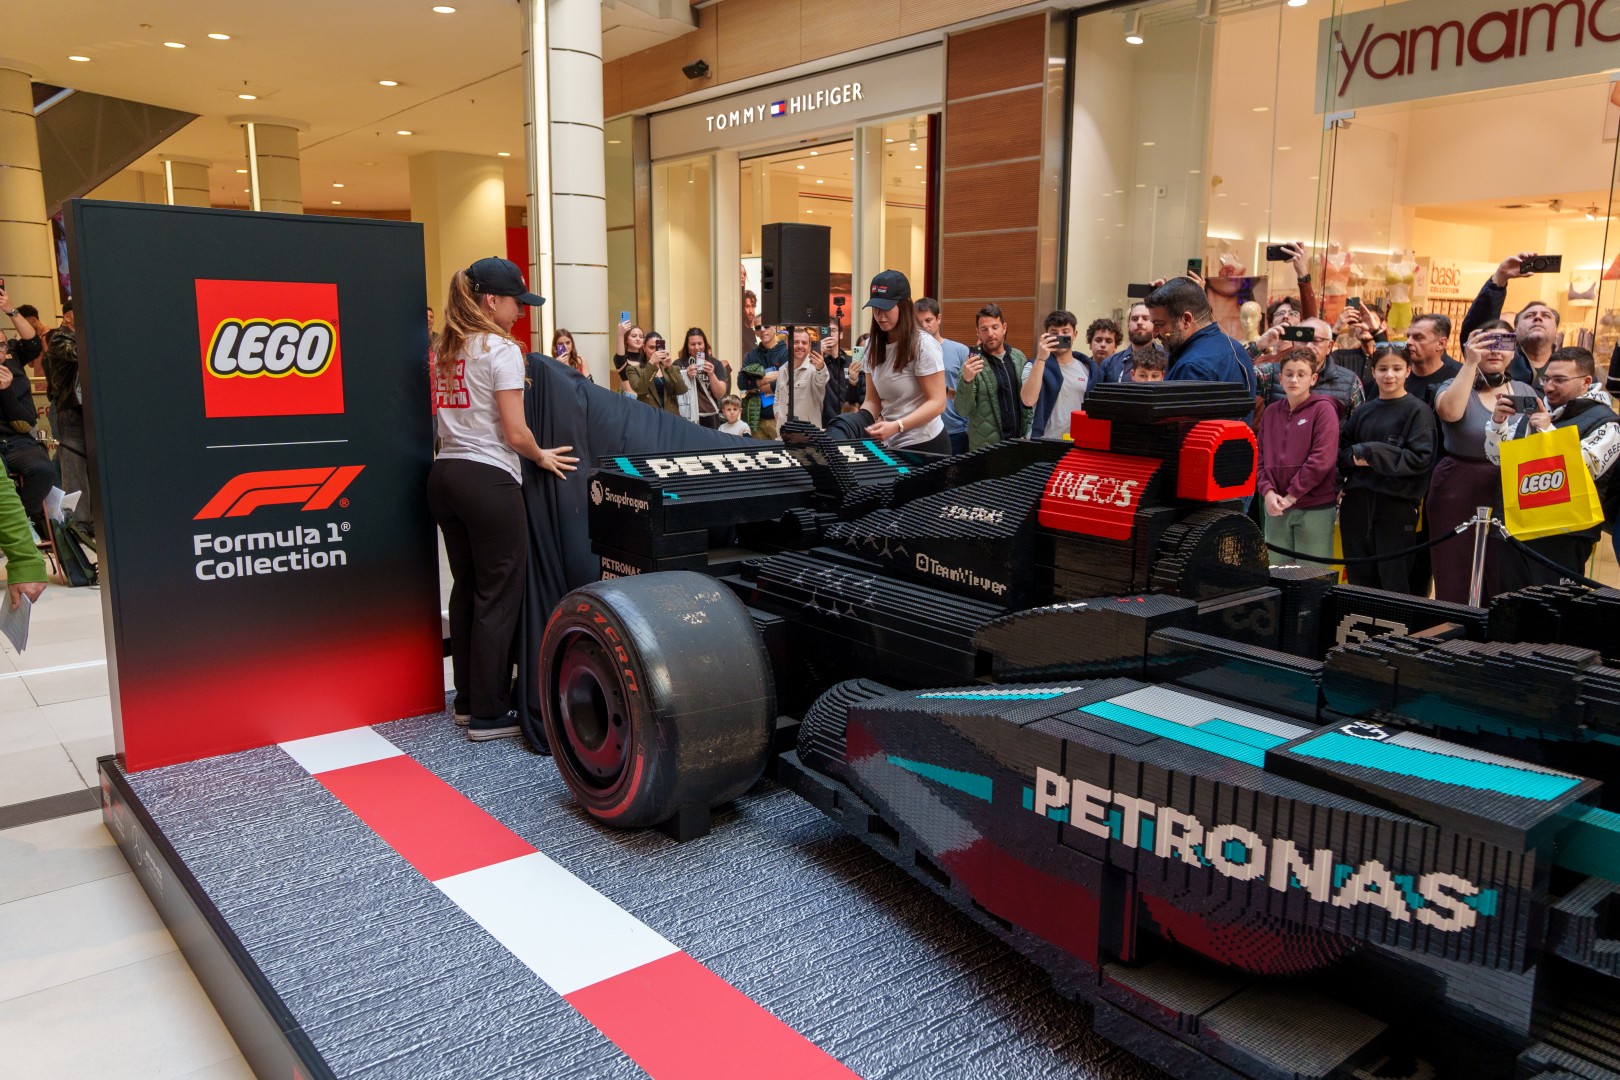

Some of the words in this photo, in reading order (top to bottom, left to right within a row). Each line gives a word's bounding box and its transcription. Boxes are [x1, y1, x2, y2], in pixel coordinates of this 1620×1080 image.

[706, 104, 766, 132] TOMMY
[790, 82, 865, 114] HILFIGER
[1430, 260, 1461, 287] basic
[209, 320, 334, 376] LEGO
[604, 487, 649, 513] Snapdragon
[1048, 470, 1139, 507] INEOS
[1519, 470, 1564, 495] LEGO
[193, 526, 321, 556] Formula
[195, 548, 347, 581] Collection
[930, 558, 1007, 595] TeamViewer
[1035, 766, 1479, 933] PETRONAS
